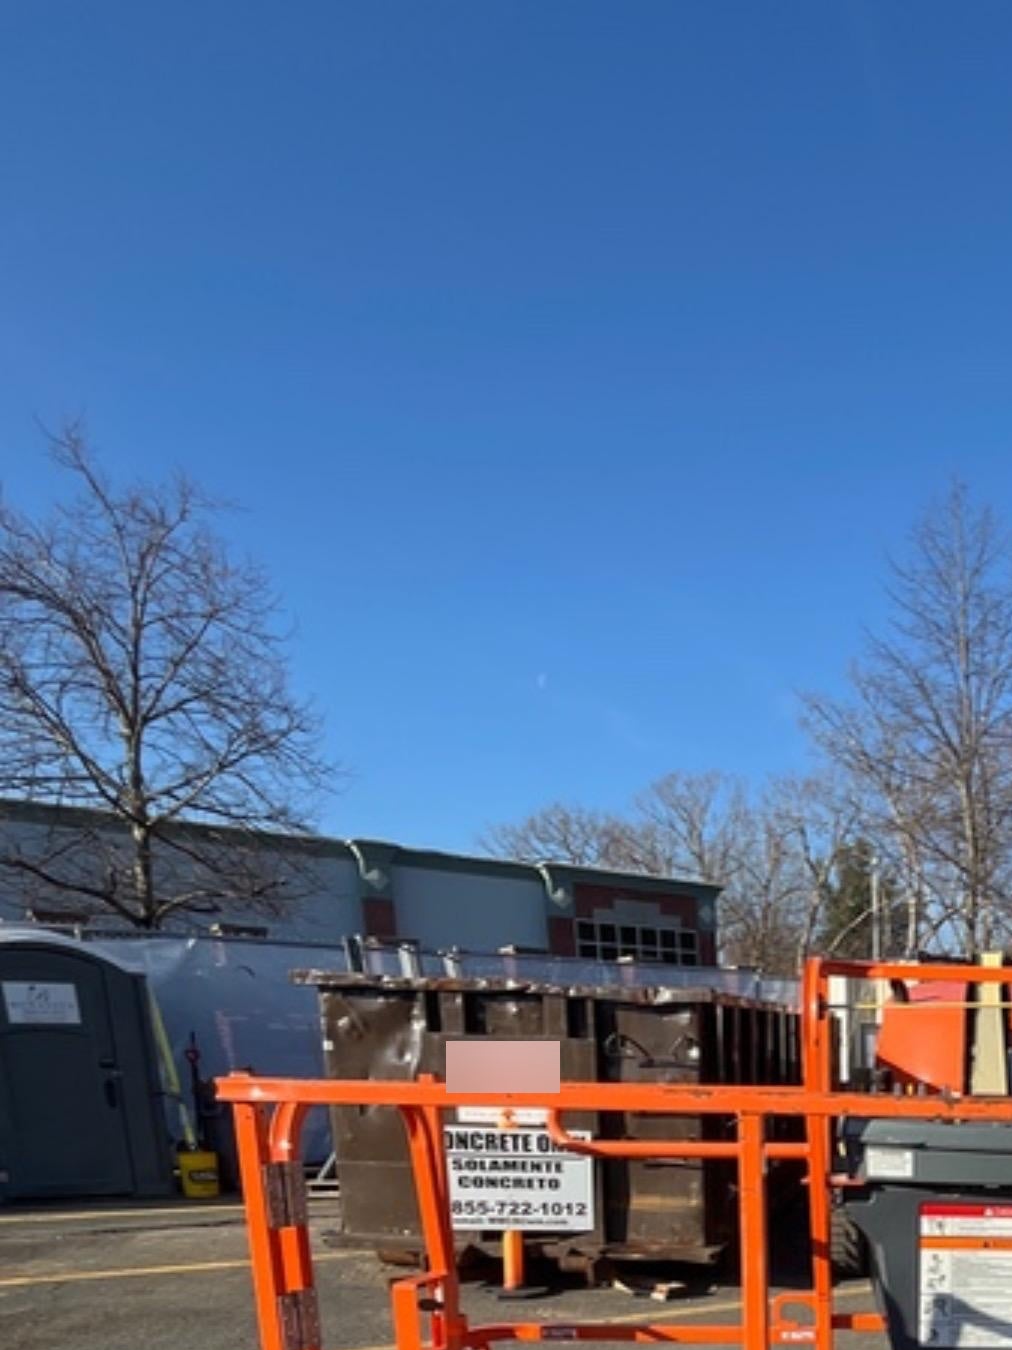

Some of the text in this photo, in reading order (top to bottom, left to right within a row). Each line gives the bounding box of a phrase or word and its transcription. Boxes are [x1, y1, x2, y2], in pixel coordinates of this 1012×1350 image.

[452, 1159, 564, 1173] SOLAMENTE
[458, 1175, 561, 1190] CONCRETO
[452, 1200, 587, 1216] 855-722-1012
